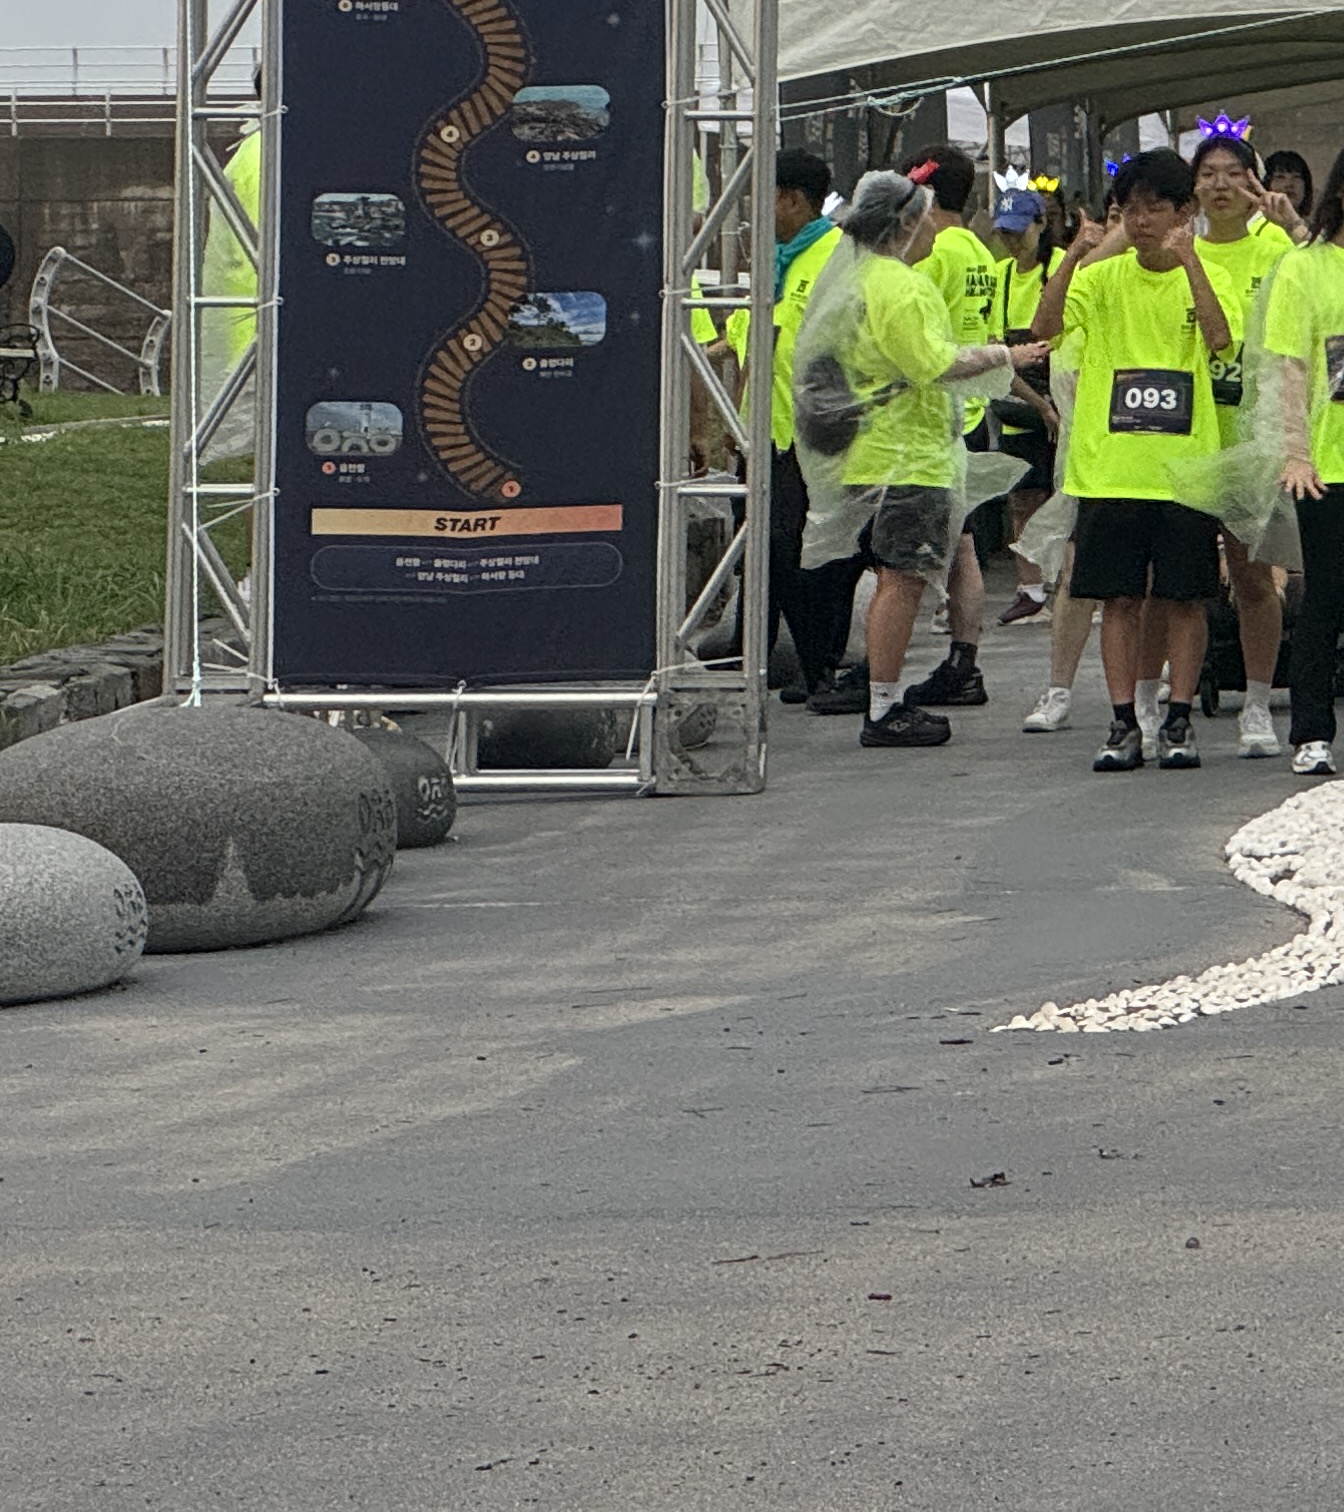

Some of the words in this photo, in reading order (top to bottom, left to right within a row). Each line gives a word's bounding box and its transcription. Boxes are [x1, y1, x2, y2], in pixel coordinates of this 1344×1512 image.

[1210, 361, 1242, 382] 92
[1125, 387, 1177, 410] 093
[434, 516, 501, 533] START
